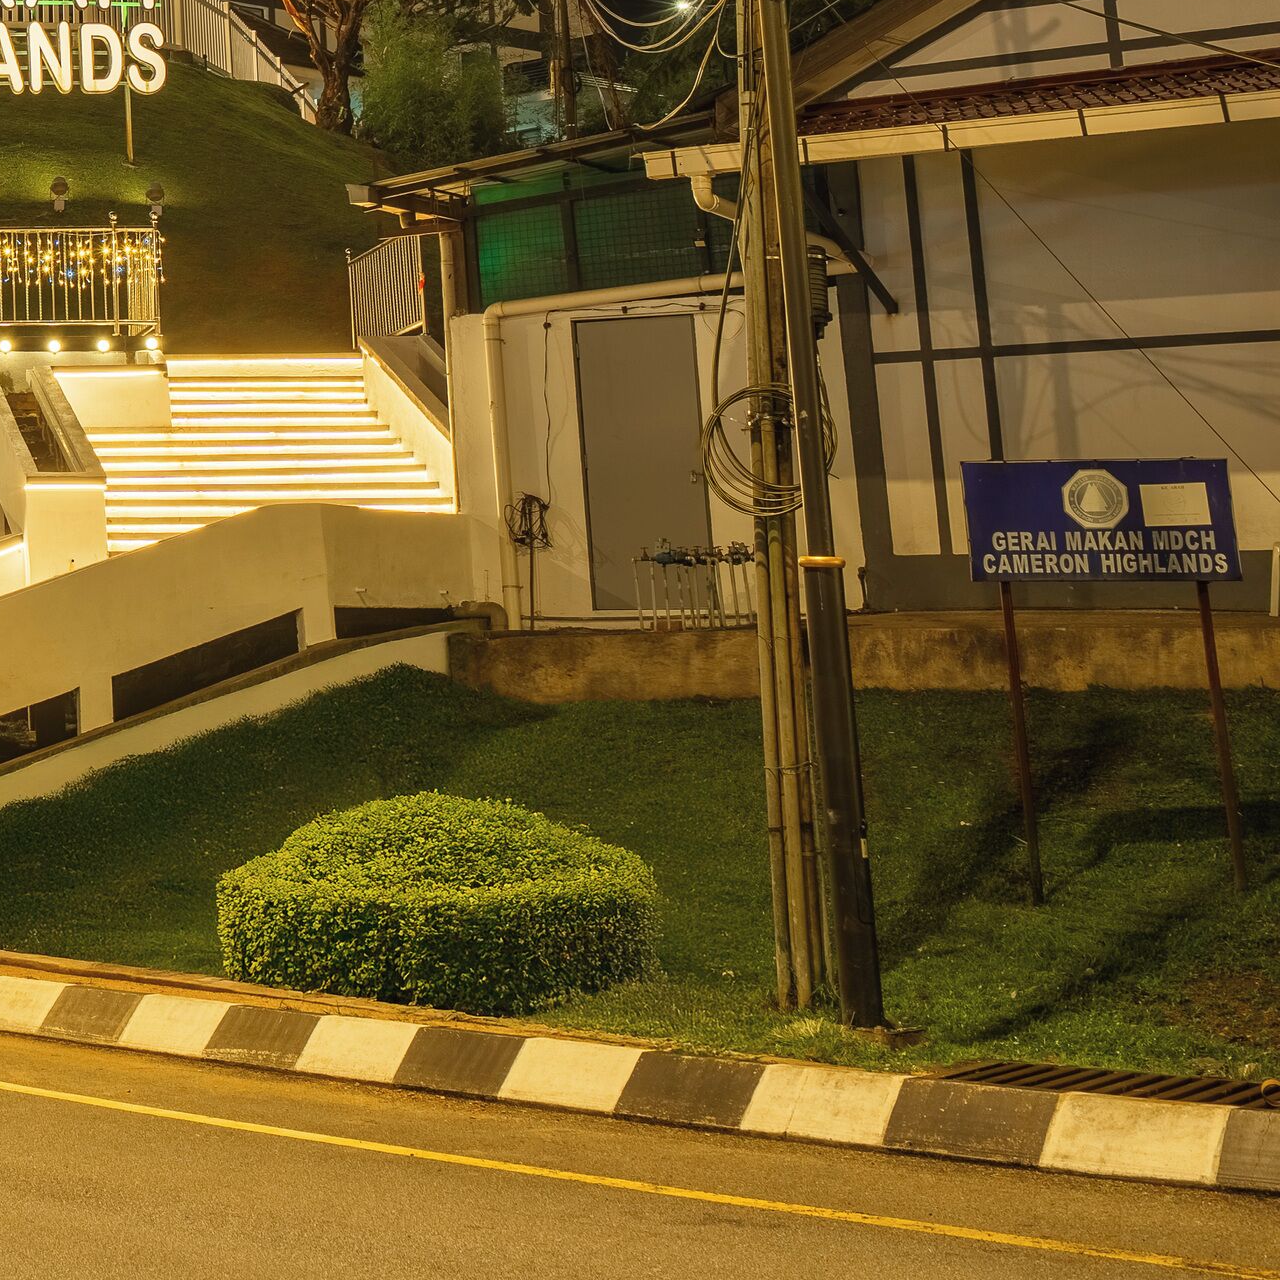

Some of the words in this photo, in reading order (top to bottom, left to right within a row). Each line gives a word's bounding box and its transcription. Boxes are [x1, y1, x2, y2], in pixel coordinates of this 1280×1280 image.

[991, 531, 1057, 551] GERAI
[1065, 531, 1144, 551] MAKAN
[1152, 530, 1217, 551] MDCH
[983, 553, 1090, 574] CAMERON
[1101, 552, 1228, 574] HIGHLANDS
